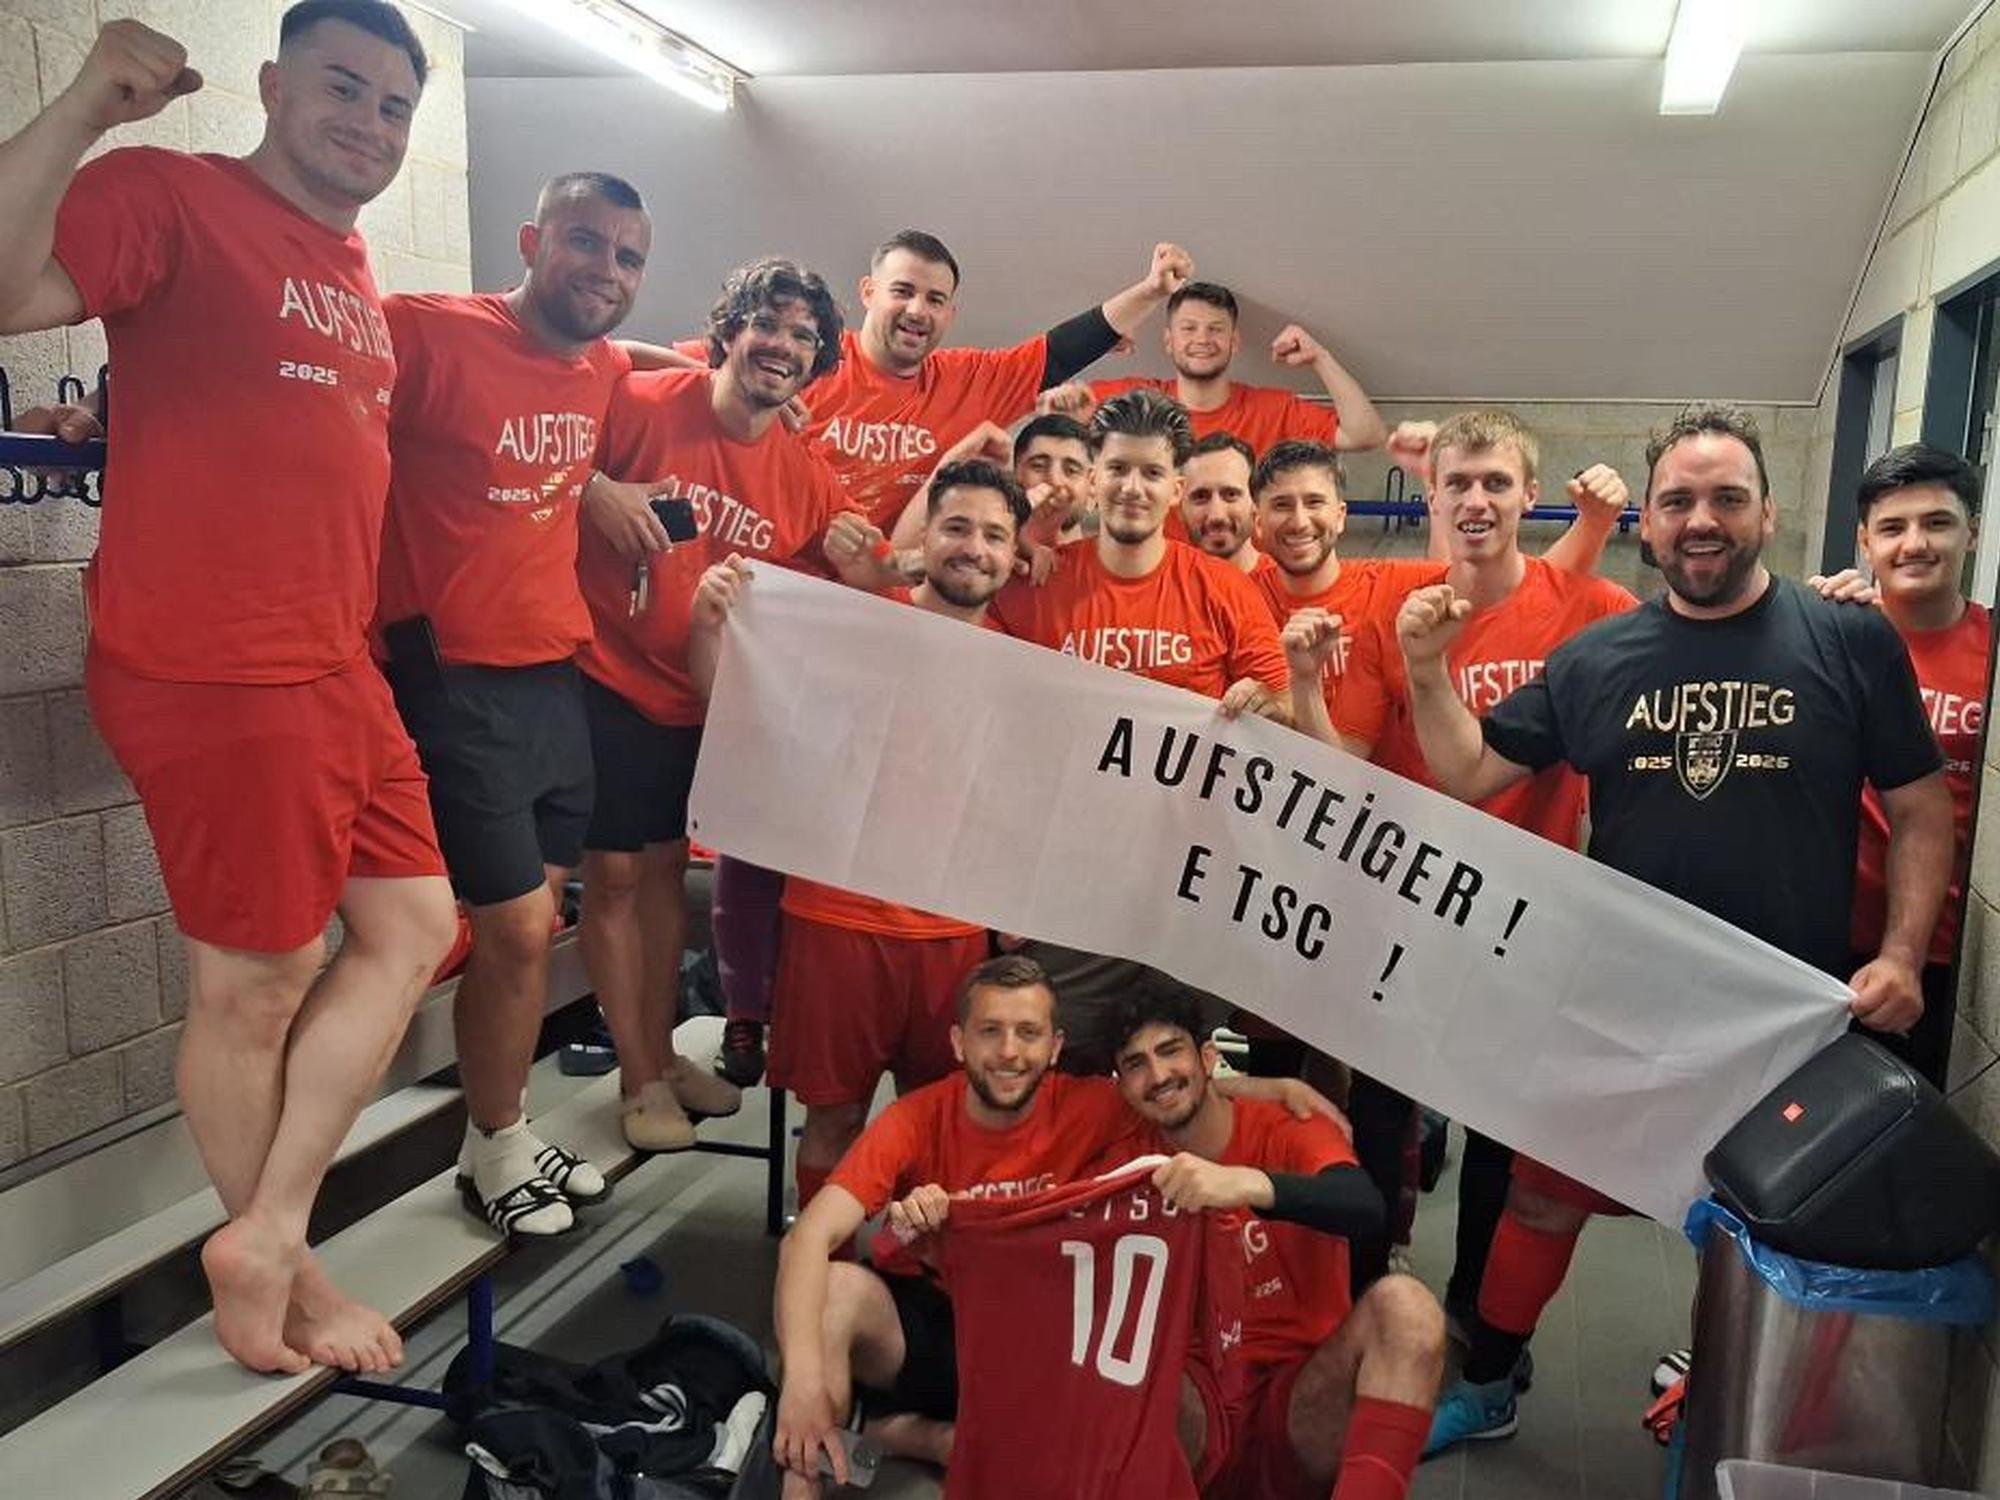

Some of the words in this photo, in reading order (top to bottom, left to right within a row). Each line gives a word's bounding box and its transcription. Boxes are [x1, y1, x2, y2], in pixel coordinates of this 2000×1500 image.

[279, 277, 391, 359] AUFSTIE
[279, 361, 339, 386] 2025
[495, 412, 597, 465] AUFSTIEG
[820, 416, 937, 463] AUFSTIEG
[1060, 627, 1192, 670] AUFSTIEG
[1625, 681, 1796, 733] AUFSTIEG
[1494, 898, 1529, 958] !
[1371, 944, 1405, 1002] !
[1061, 1234, 1169, 1387] 10
